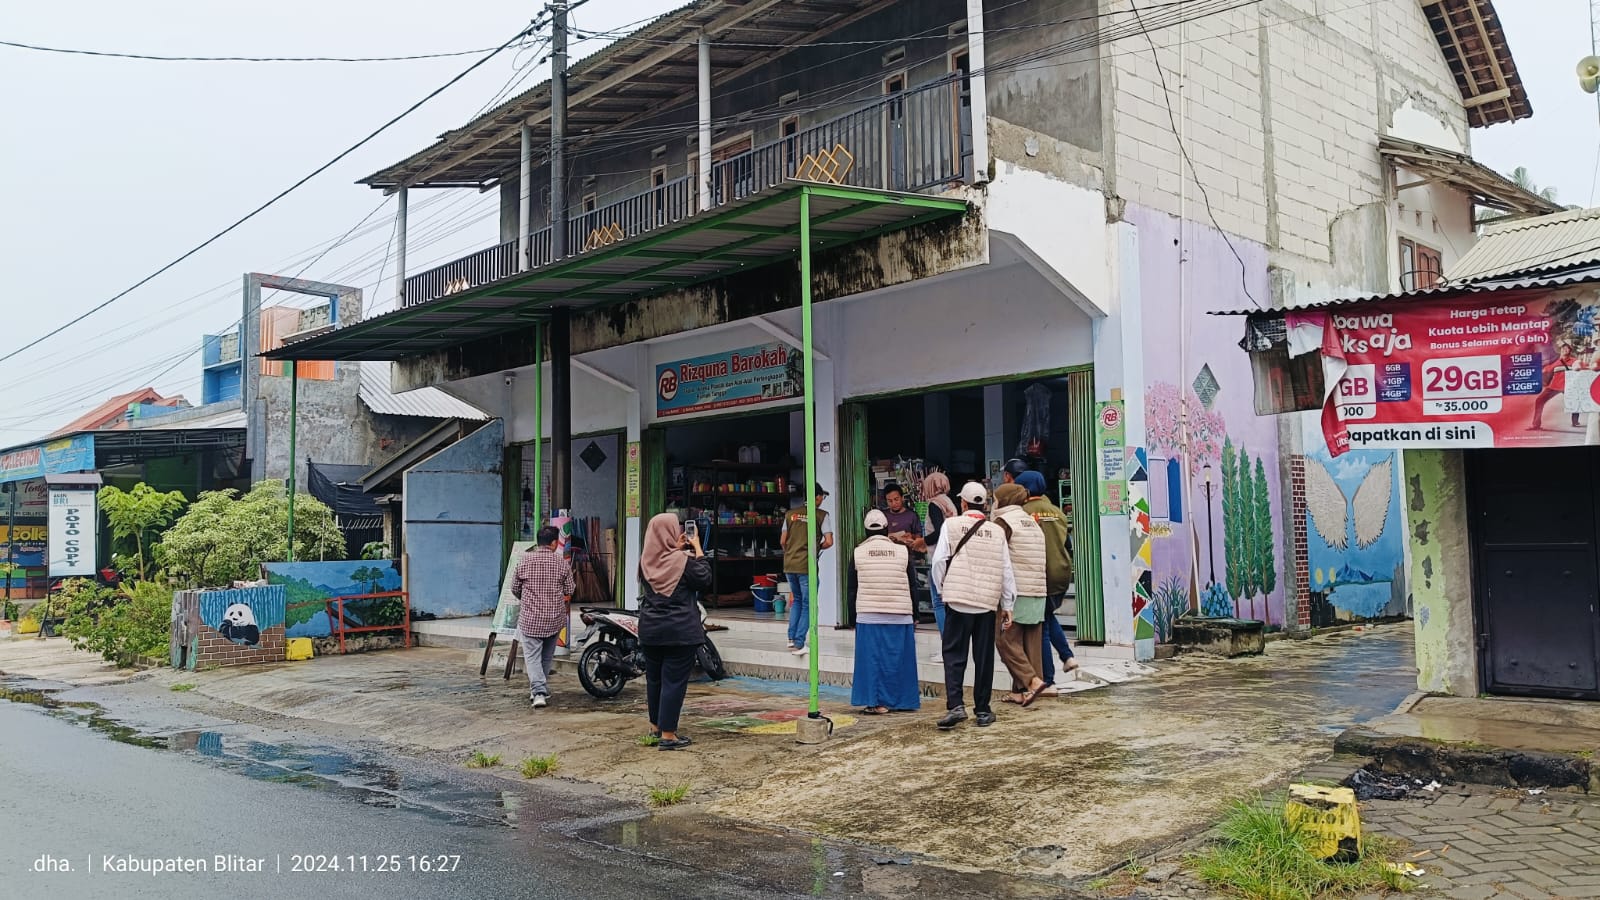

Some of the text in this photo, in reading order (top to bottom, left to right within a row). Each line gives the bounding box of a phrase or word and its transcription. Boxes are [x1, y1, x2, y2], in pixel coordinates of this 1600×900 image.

[1450, 305, 1526, 320] Harga Tetap
[1333, 314, 1393, 330] bawa
[1429, 319, 1550, 337] Kuota Lebih Mantap
[1340, 328, 1412, 356] ks aja
[1430, 341, 1460, 350] Bonus
[1462, 338, 1499, 349] Selama
[1500, 338, 1513, 346] 6x
[1529, 333, 1549, 345] bln)
[680, 344, 787, 383] Rizquna Barokah
[1510, 354, 1533, 363] 15GB
[1385, 364, 1401, 372] 6GB
[1426, 365, 1499, 392] 29GB
[1443, 401, 1488, 412] 35.000
[1425, 427, 1442, 441] di
[1445, 426, 1476, 441] sini
[65, 540, 80, 567] COPY
